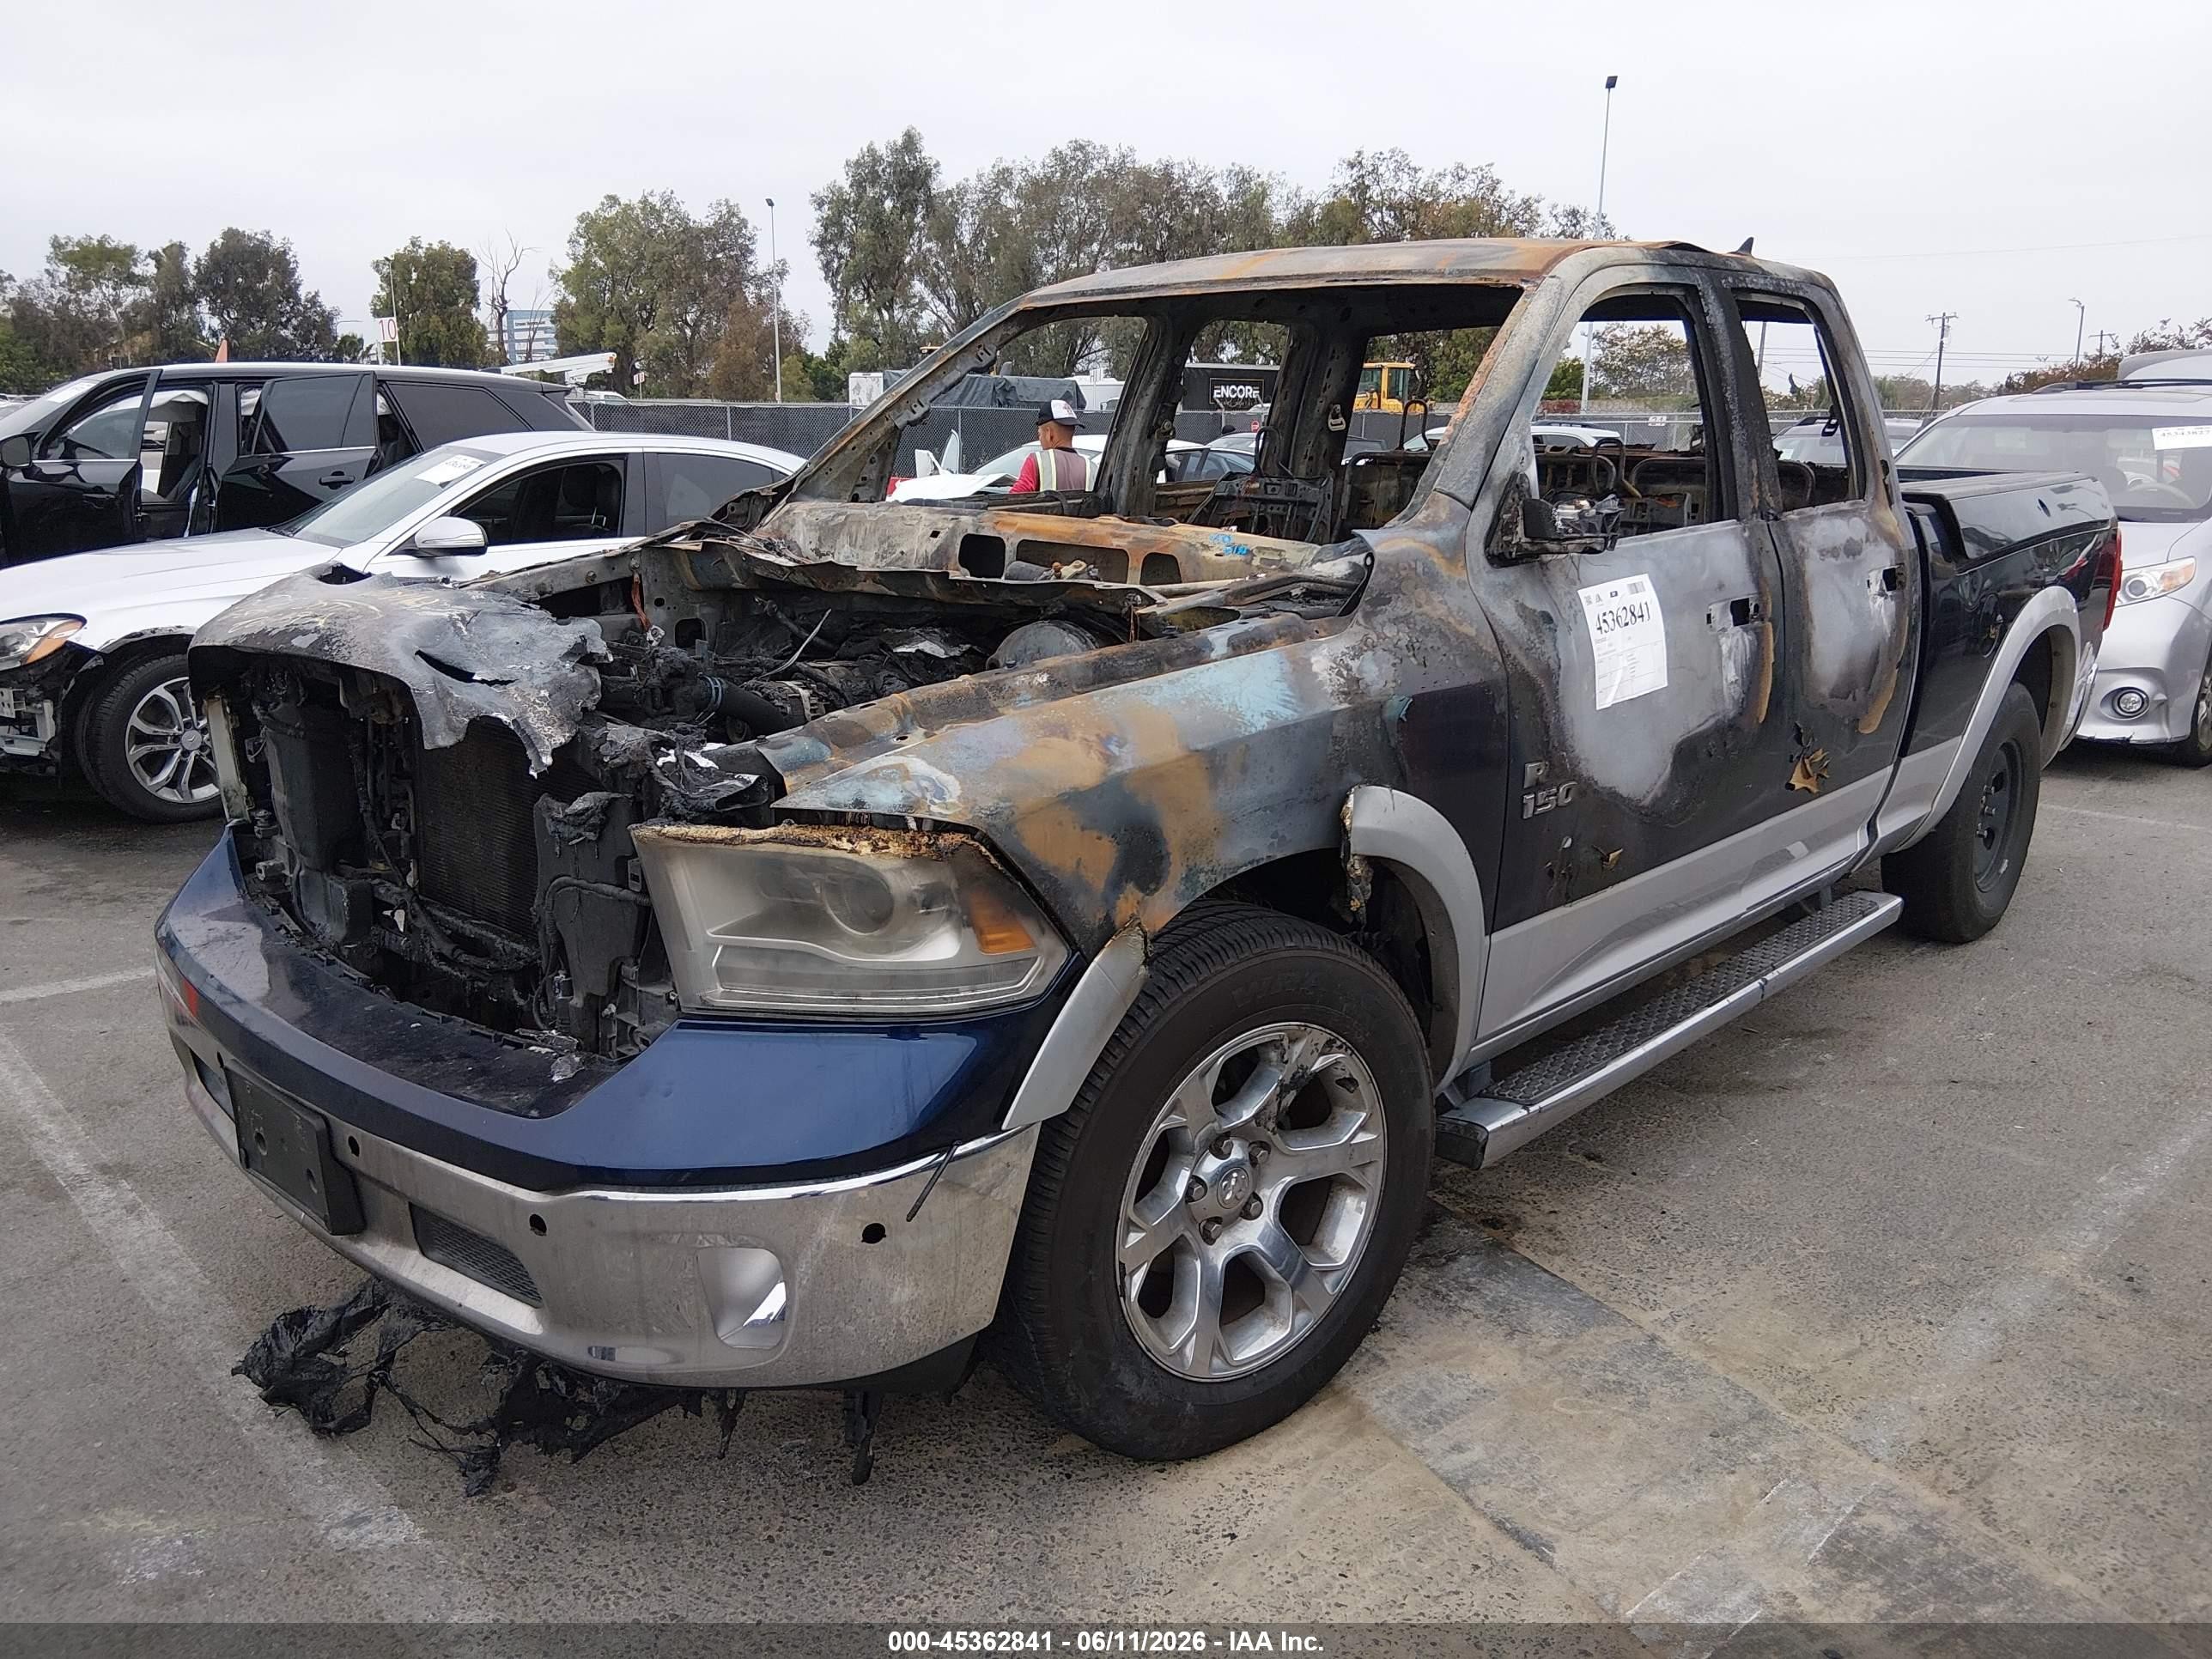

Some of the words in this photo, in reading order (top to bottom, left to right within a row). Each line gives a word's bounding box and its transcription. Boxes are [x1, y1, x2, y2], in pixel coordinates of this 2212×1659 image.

[379, 319, 397, 341] 10
[1213, 385, 1260, 398] ENCORE
[1595, 601, 1650, 635] 45362841
